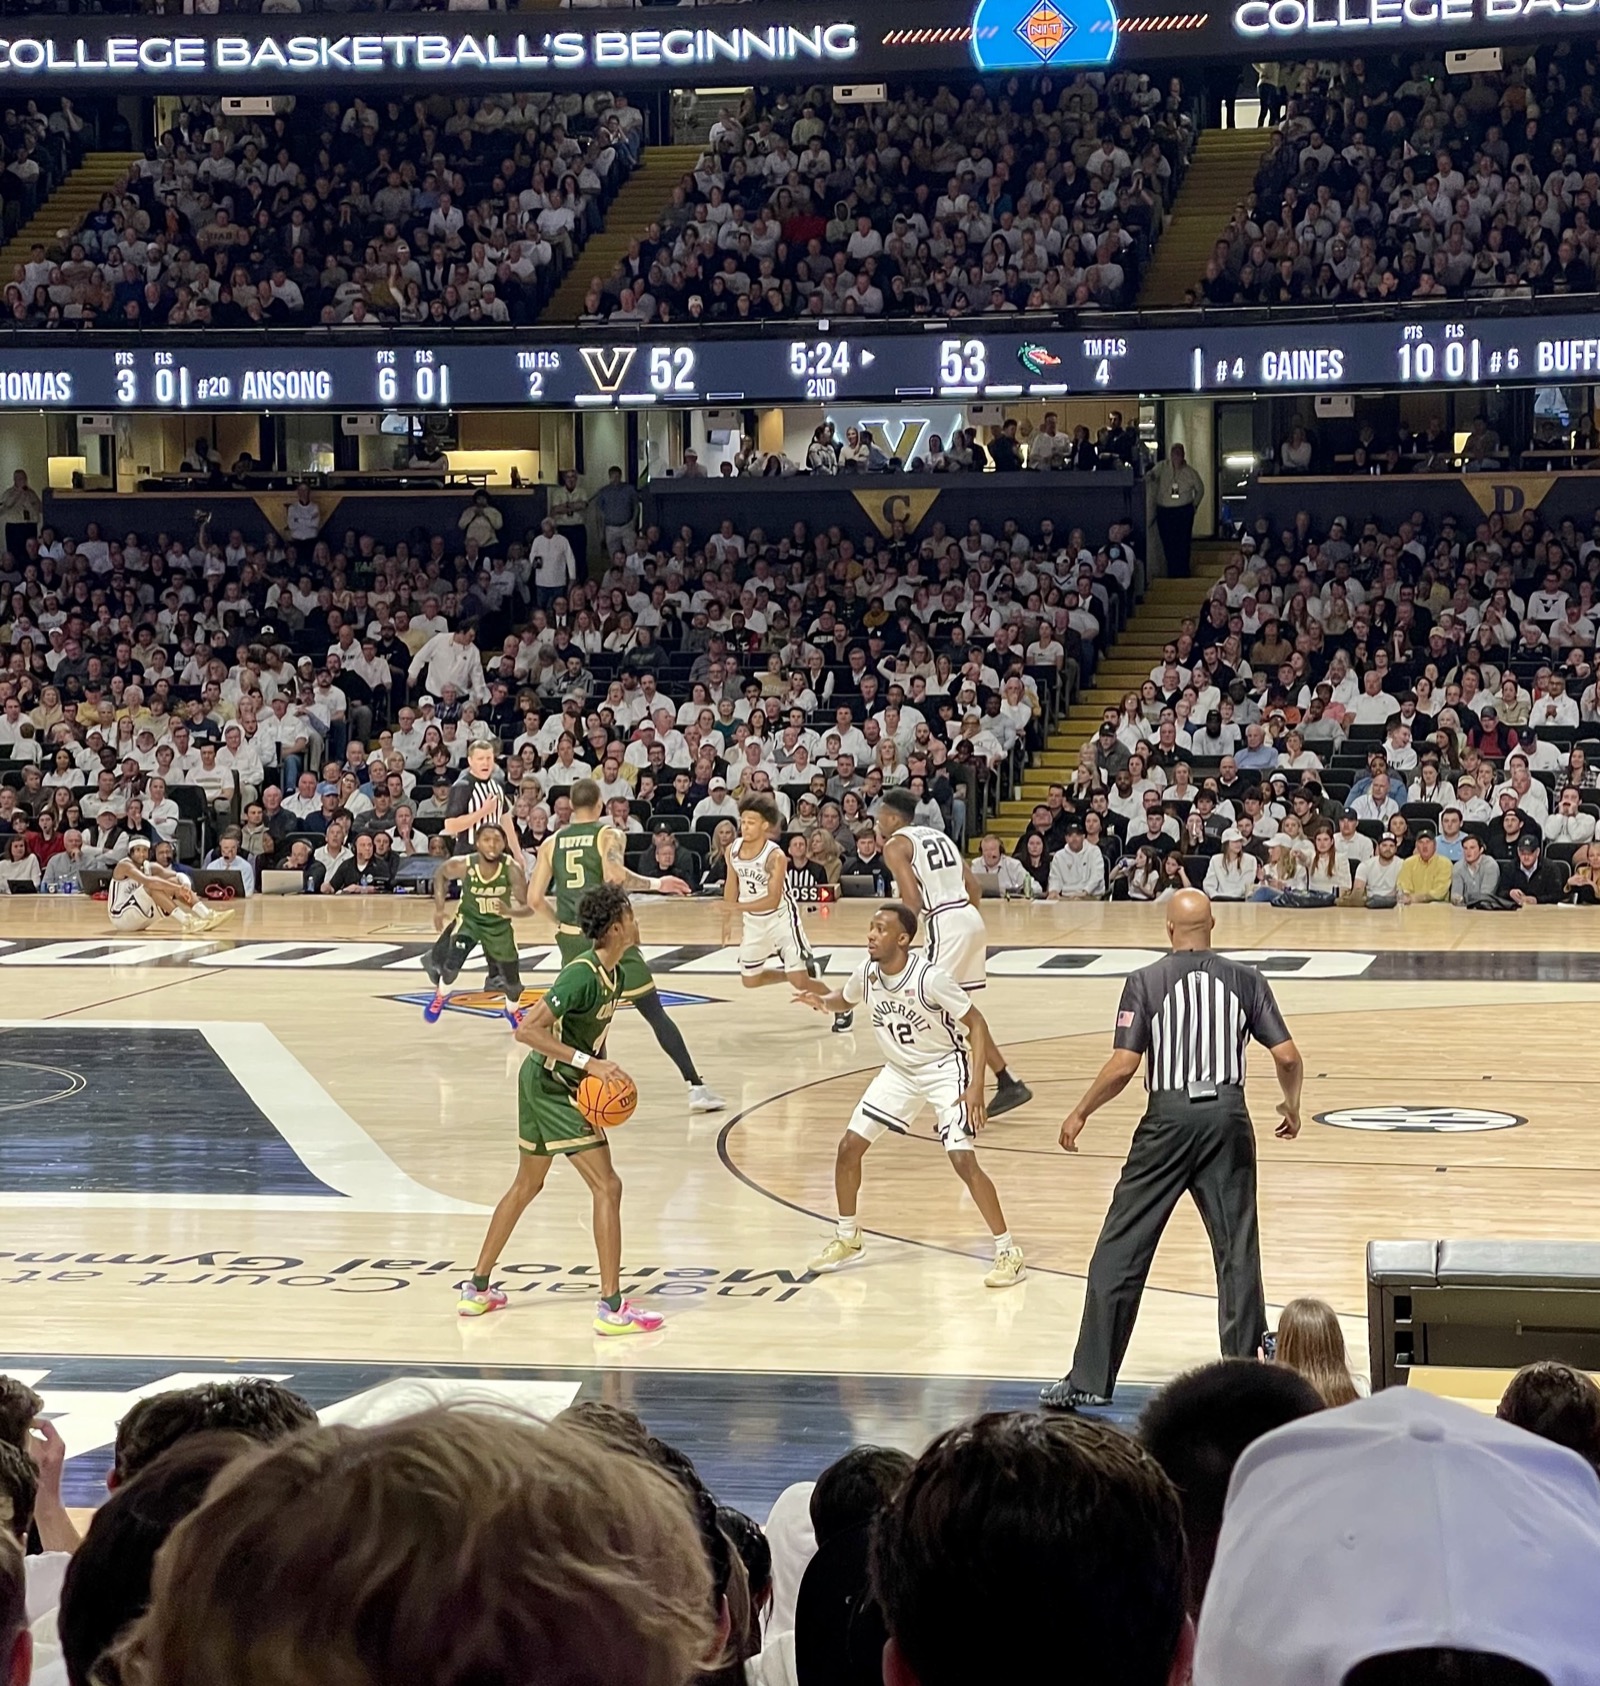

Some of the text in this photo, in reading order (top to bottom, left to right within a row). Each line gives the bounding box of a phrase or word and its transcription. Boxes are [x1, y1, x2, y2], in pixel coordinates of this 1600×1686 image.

[1030, 23, 1061, 36] NIT
[1234, 0, 1600, 32] COLLEGE BA
[0, 24, 858, 68] OLLEGE BASKETBALL'S BEGINNING
[1404, 324, 1464, 339] PTS FLS
[115, 352, 173, 365] PTS FLS
[377, 350, 433, 363] PTS FLS
[517, 352, 559, 368] TM FLS
[791, 341, 850, 374] 5:24
[940, 340, 986, 383] 53
[1084, 338, 1127, 356] TM FLS
[1398, 341, 1463, 379] 10 0
[1538, 338, 1600, 372] BUFF
[579, 348, 637, 391] V
[650, 347, 695, 390] 52
[1095, 358, 1109, 384] 4
[1232, 357, 1244, 379] 4
[1262, 350, 1344, 380] GAINES
[117, 369, 136, 401] 3
[155, 369, 173, 401] 0
[197, 371, 332, 400] #20 ANSONG
[379, 367, 433, 400] 6 0
[529, 372, 543, 397] 2
[806, 379, 837, 398] 2ND
[882, 495, 910, 524] C
[1491, 485, 1524, 514] D
[566, 849, 585, 888] 5
[922, 837, 957, 871] 20
[470, 886, 506, 896] UAB
[746, 880, 757, 894] 3
[872, 1000, 932, 1033] VANDERBILT
[888, 1023, 915, 1045] 12
[0, 1269, 103, 1284] at
[128, 1271, 410, 1293] Court
